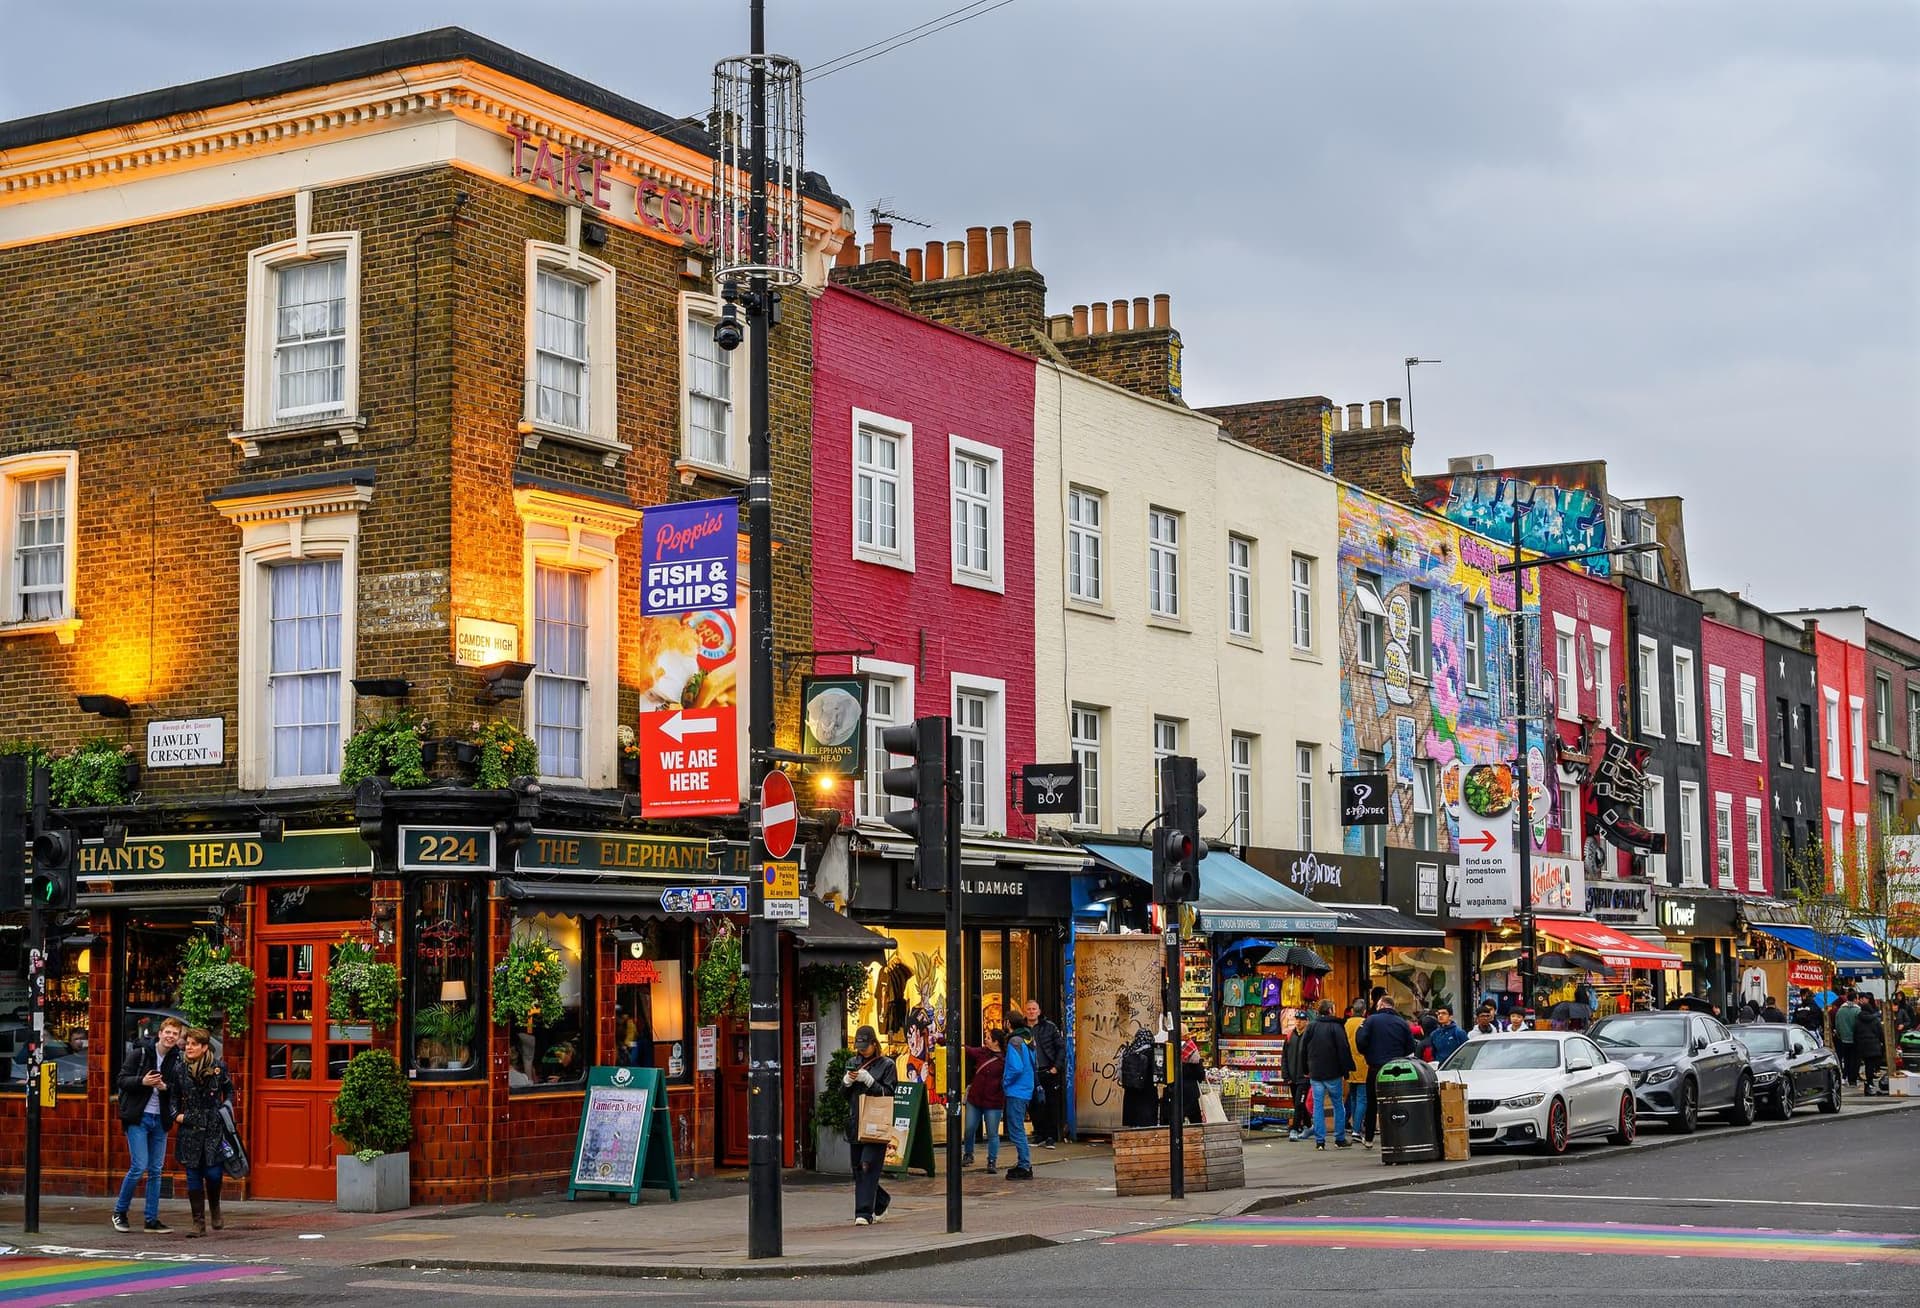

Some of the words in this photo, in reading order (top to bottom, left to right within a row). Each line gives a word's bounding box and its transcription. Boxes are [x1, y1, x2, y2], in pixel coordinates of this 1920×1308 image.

[506, 124, 612, 211] TAKE
[656, 511, 723, 560] Poppies
[648, 563, 703, 587] FISH
[708, 561, 728, 582] &
[648, 582, 728, 608] CHIPS
[458, 632, 491, 648] CAMDEN
[494, 638, 513, 651] HIGH
[458, 647, 486, 662] STREET
[152, 733, 201, 747] HAWLEY
[150, 747, 208, 762] CRESCENT
[209, 751, 221, 759] NW1
[811, 746, 853, 755] ELEPHANTS
[660, 750, 684, 770] WE
[687, 748, 718, 768] ARE
[820, 754, 842, 763] HEAD
[669, 771, 710, 792] HERE
[1038, 792, 1064, 805] BOY
[188, 841, 264, 868] HEAD
[417, 835, 479, 863] 224
[536, 838, 580, 865] THE
[600, 840, 717, 871] ELEPHANTS
[1466, 857, 1480, 865] find
[1466, 866, 1506, 876] jamestown
[1532, 862, 1562, 898] London
[977, 880, 1024, 896] DAMAGE
[1466, 896, 1507, 908] wagamama
[1796, 964, 1822, 973] MONEY
[1791, 972, 1824, 981] EXCHANG
[592, 1098, 626, 1112] Camden's
[626, 1102, 642, 1113] Best
